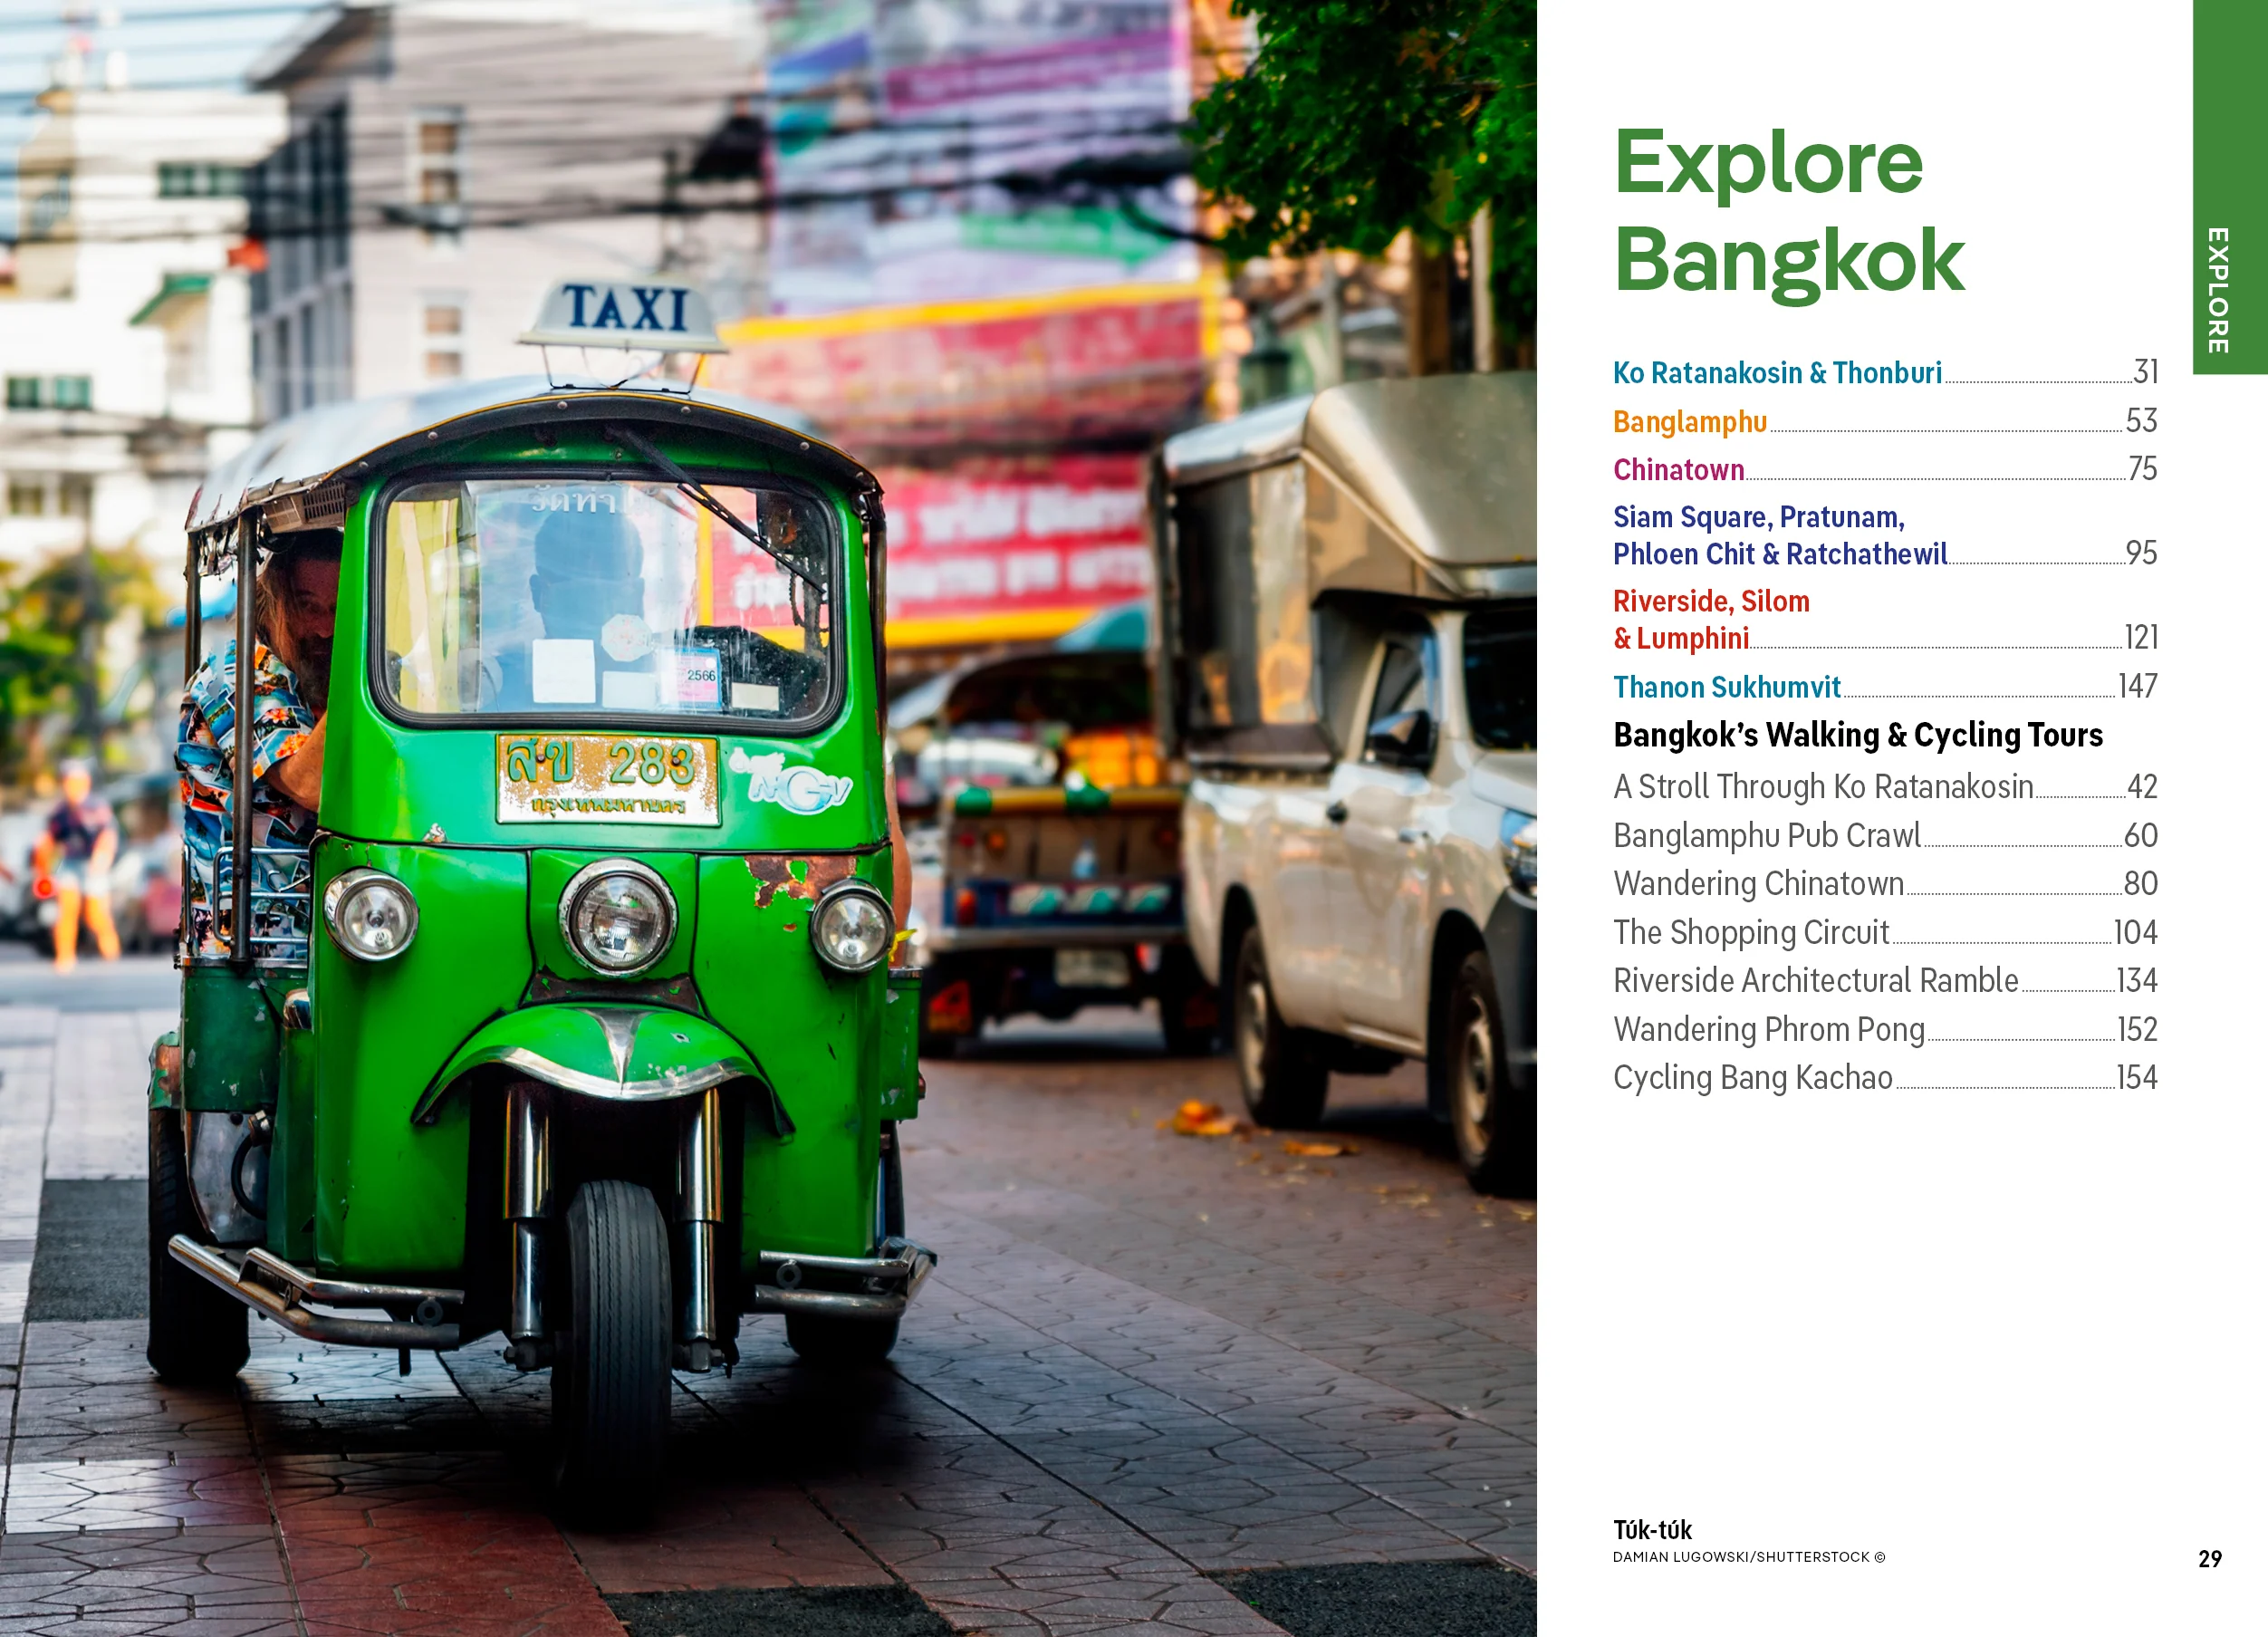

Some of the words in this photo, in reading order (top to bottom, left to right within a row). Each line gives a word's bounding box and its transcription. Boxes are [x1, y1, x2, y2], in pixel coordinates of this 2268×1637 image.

[562, 284, 689, 332] TAXI
[687, 670, 716, 681] 2566
[507, 737, 573, 782] สข
[610, 740, 695, 785] 283
[532, 795, 686, 818] กรุงเทพมหานคร
